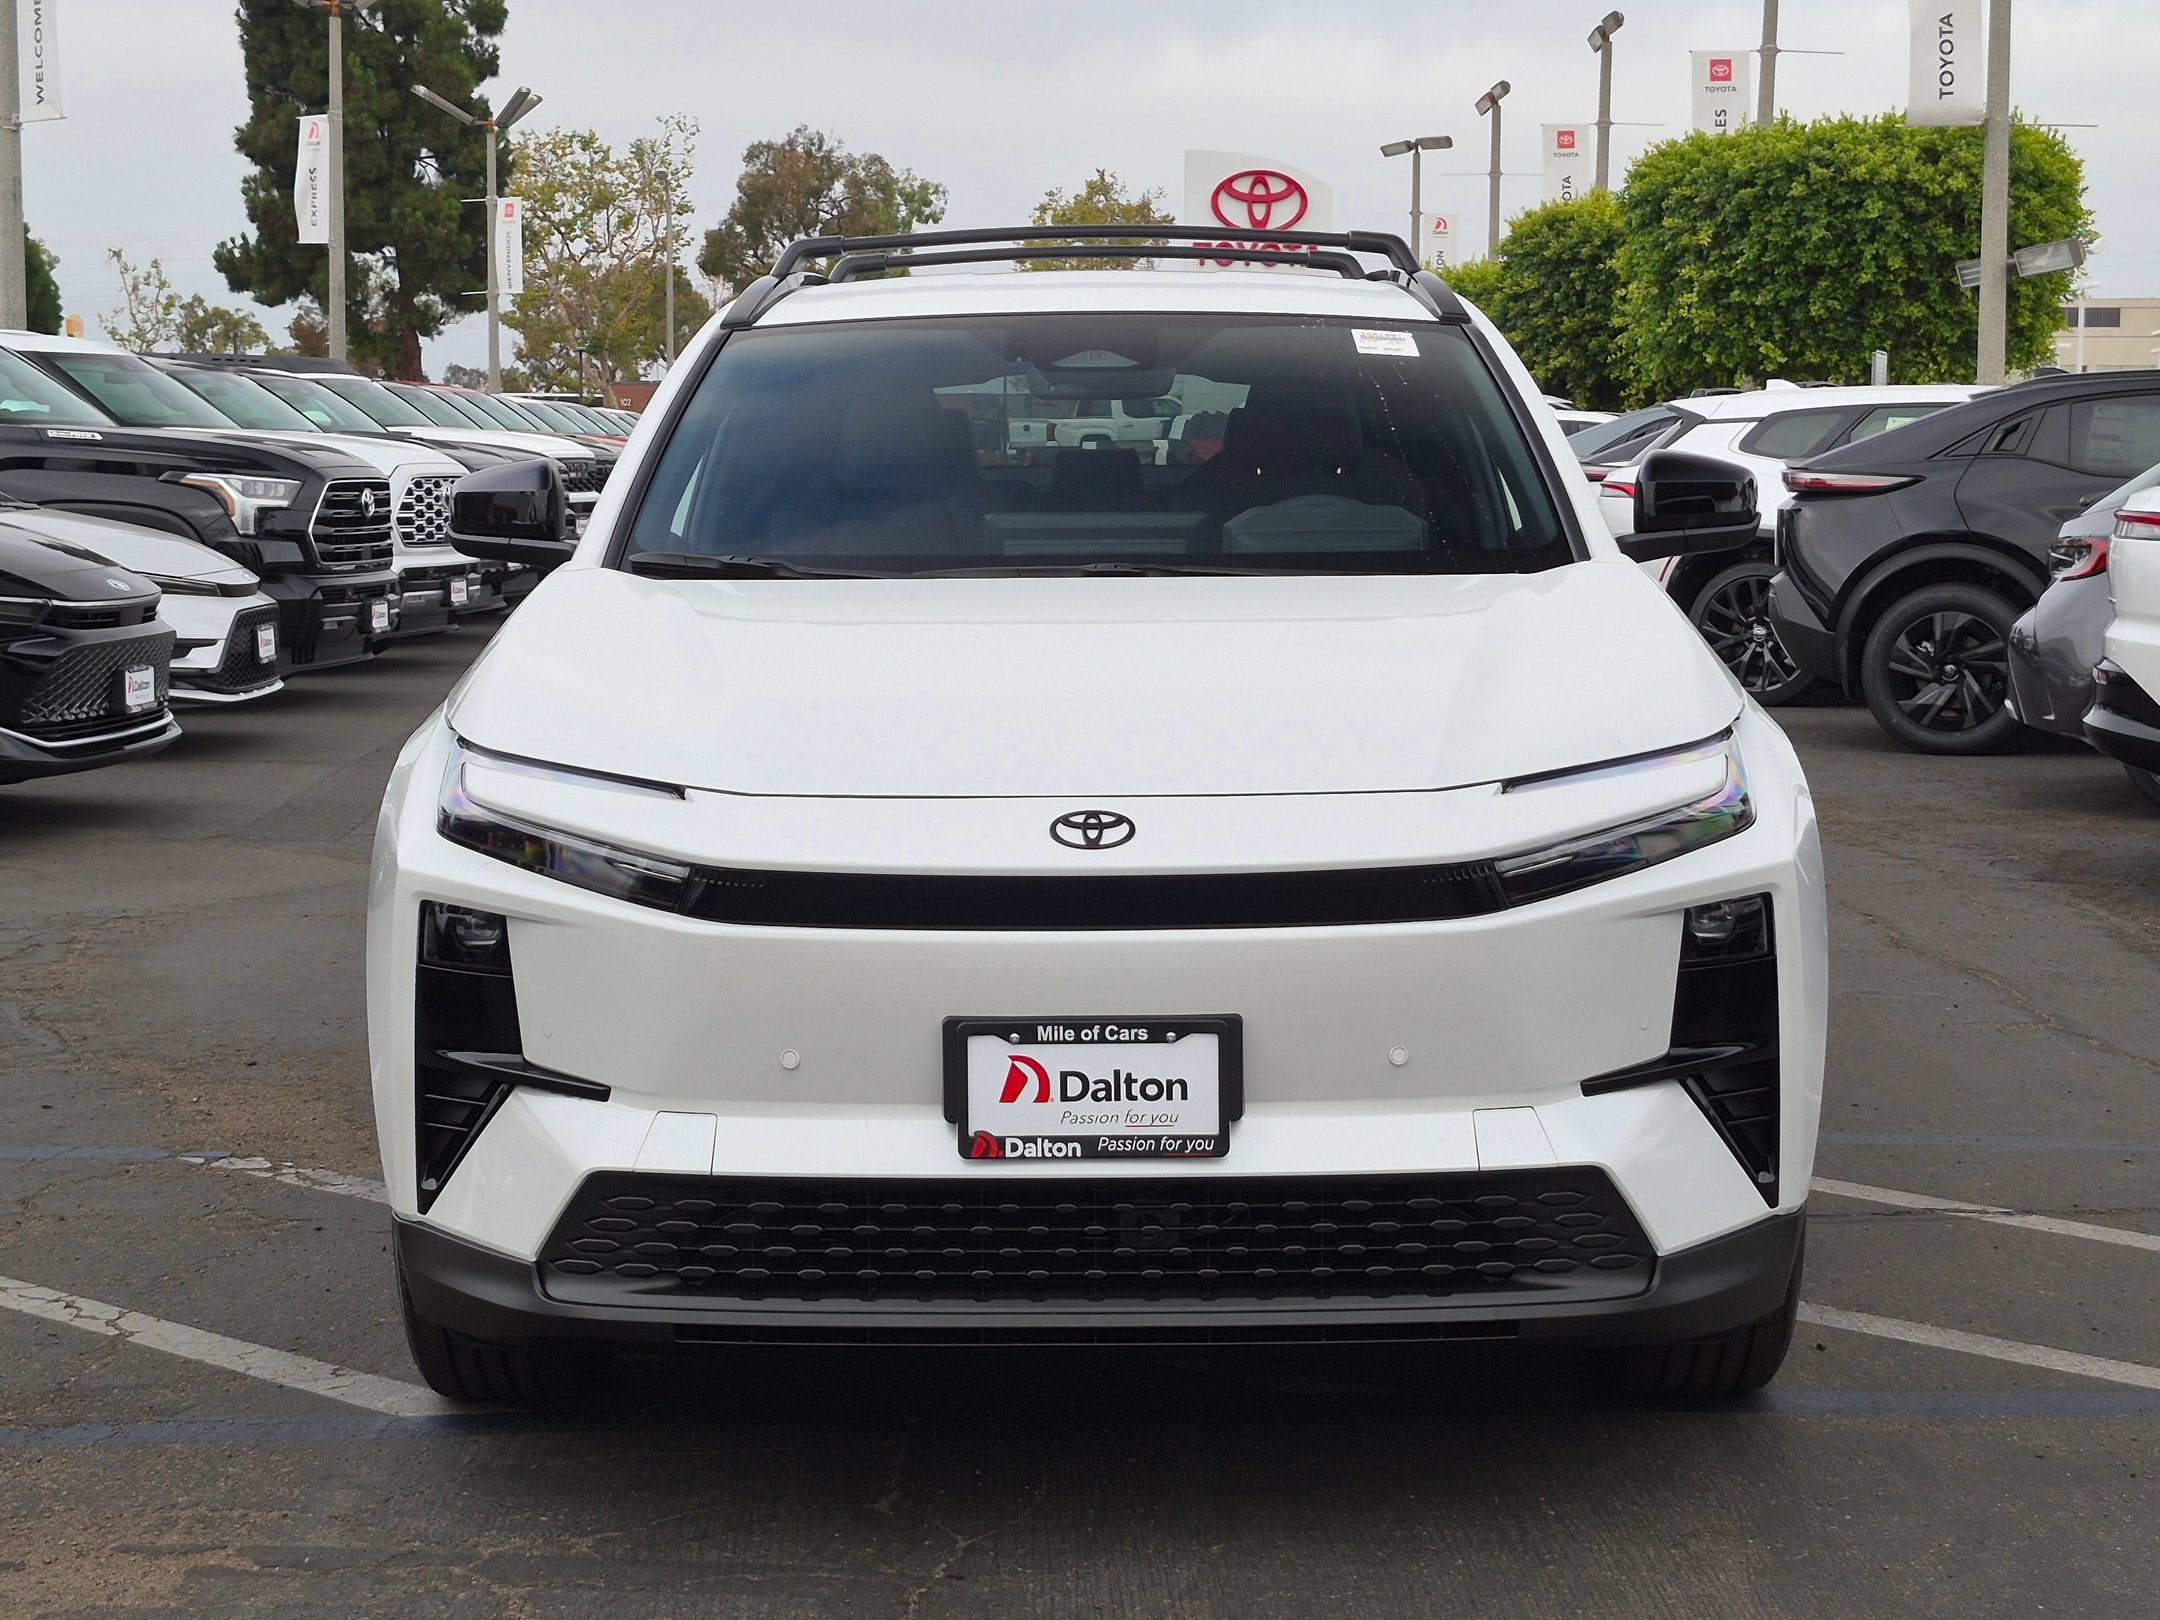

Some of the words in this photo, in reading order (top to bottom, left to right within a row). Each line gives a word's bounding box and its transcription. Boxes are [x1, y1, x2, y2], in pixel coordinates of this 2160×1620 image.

[1939, 12, 1954, 100] TOYOTA
[309, 167, 318, 227] EXPRESS
[1037, 1025, 1075, 1041] Mile
[1080, 1025, 1100, 1041] of
[1104, 1025, 1148, 1041] Cars
[1059, 1069, 1188, 1102] Dalton
[1060, 1110, 1119, 1125] Passion
[1124, 1109, 1147, 1124] for
[1149, 1111, 1179, 1126] you
[1005, 1137, 1081, 1158] Dalton
[1097, 1136, 1155, 1151] Passion
[1159, 1135, 1183, 1151] for
[1184, 1138, 1214, 1153] you
